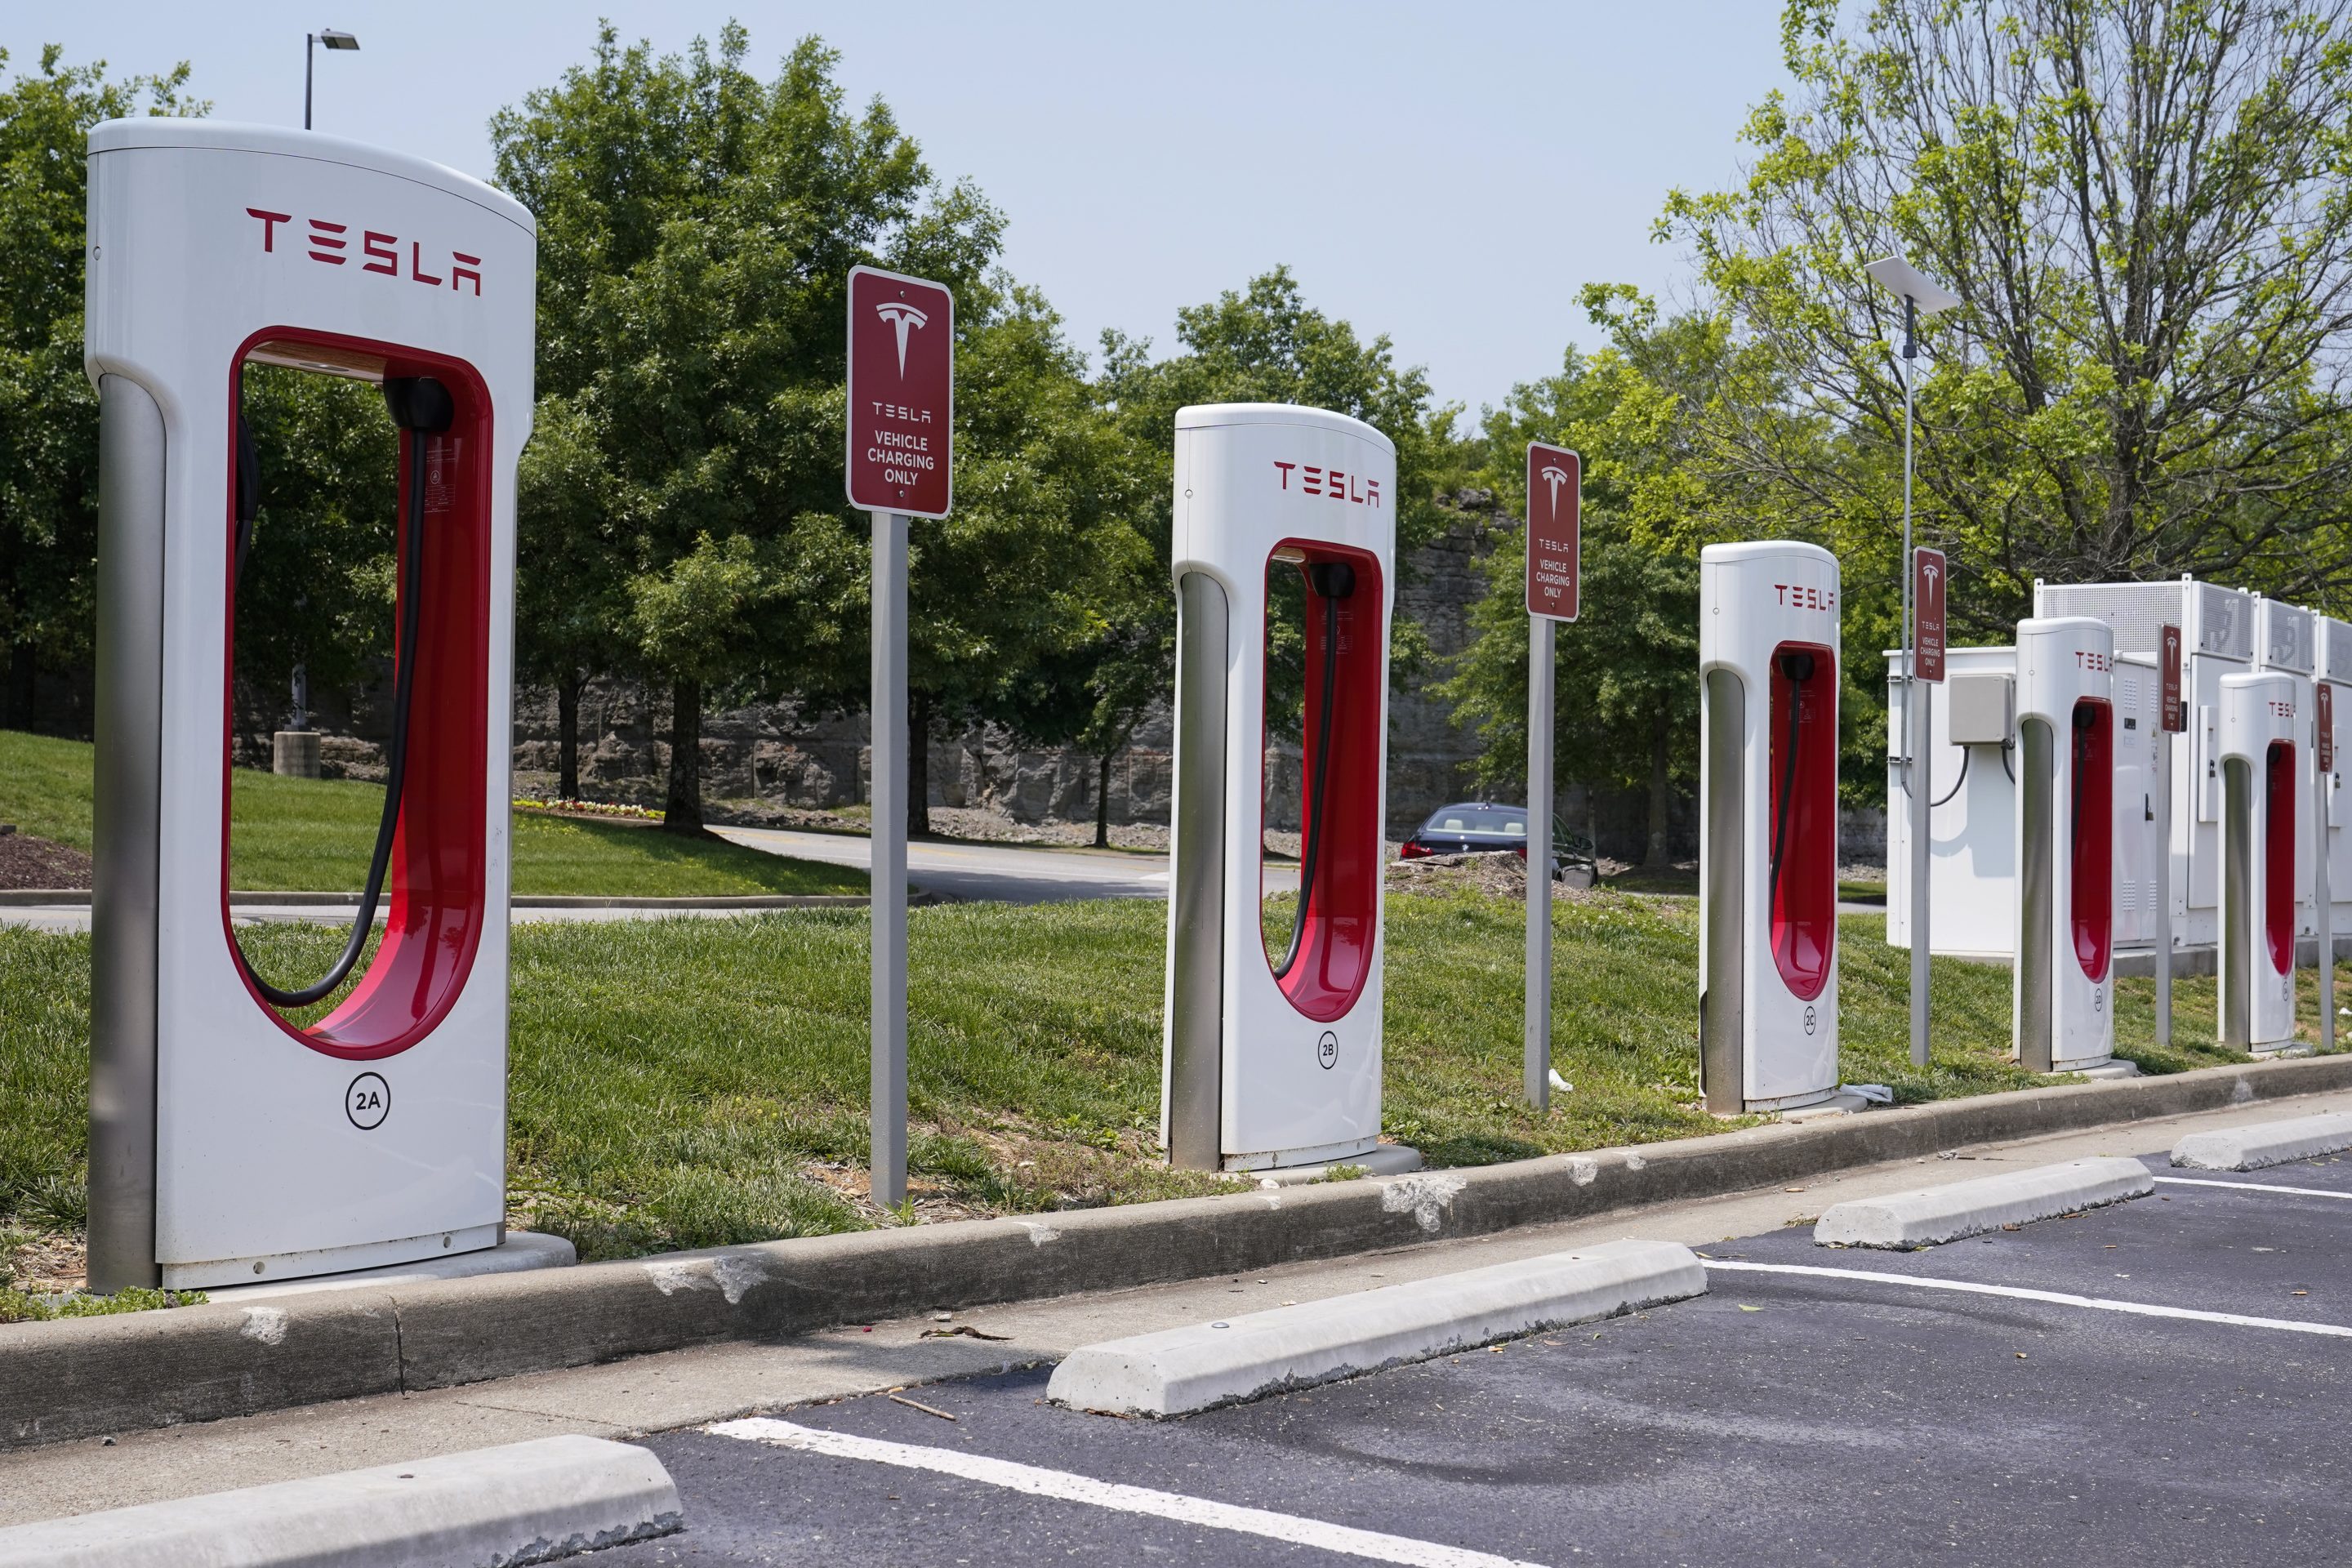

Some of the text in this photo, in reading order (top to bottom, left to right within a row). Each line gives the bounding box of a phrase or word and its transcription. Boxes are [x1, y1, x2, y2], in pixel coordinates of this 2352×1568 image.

[246, 207, 482, 296] TESLA
[871, 401, 931, 424] TESLA
[875, 430, 928, 452] VEHICLE
[867, 448, 934, 470] CHARGING
[884, 468, 918, 486] ONLY
[1273, 461, 1379, 509] TESLA
[1539, 538, 1569, 553] TESLA
[1539, 559, 1567, 573] VEHICLE
[1536, 572, 1570, 586] CHARGING
[1544, 586, 1561, 598] ONLY
[1774, 584, 1834, 612] TESLA
[1922, 621, 1940, 631] TESLA
[1922, 637, 1939, 648] VEHICLE
[1920, 647, 1940, 657] CHARGING
[1924, 657, 1936, 666] ONLY
[1806, 1014, 1814, 1027] 2C
[1322, 1044, 1334, 1056] 2B
[355, 1090, 381, 1111] 2A
